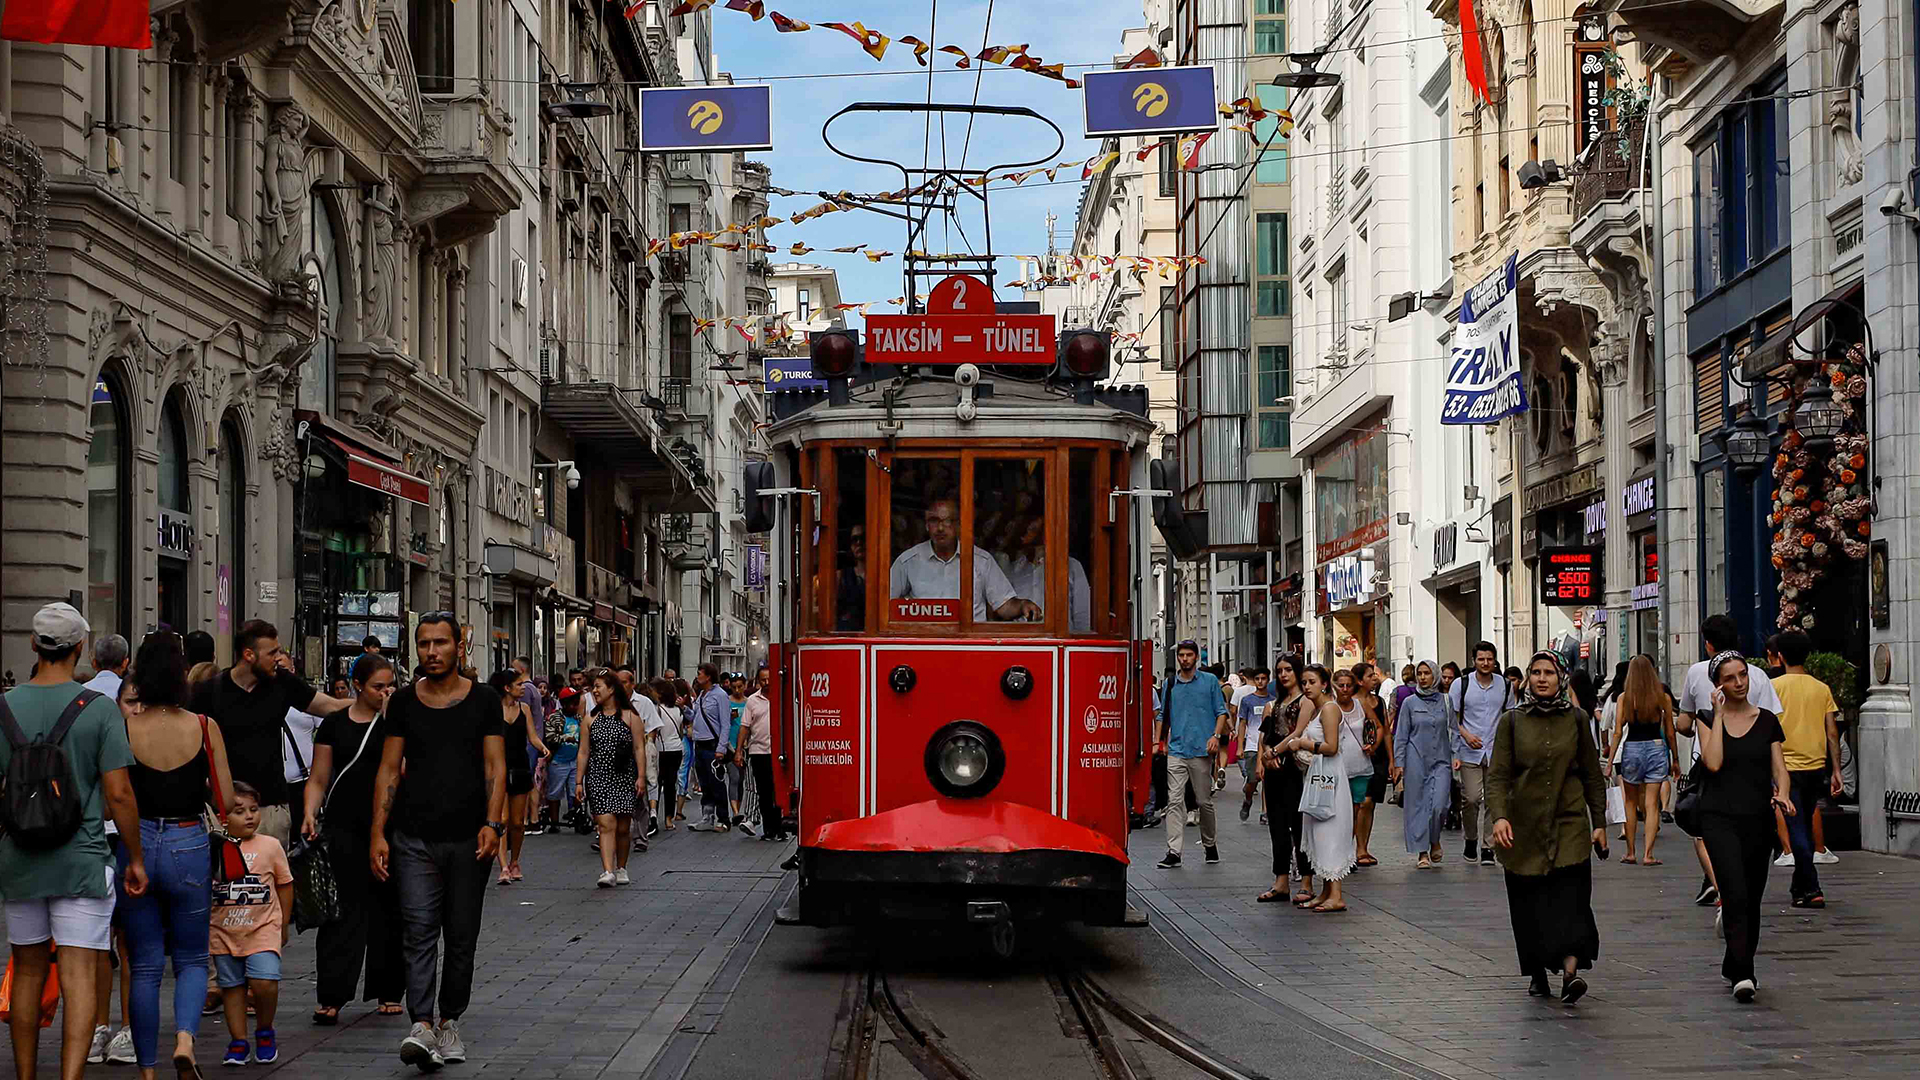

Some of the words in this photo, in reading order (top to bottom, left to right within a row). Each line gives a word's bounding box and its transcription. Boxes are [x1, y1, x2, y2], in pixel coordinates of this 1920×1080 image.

[953, 280, 967, 310] 2
[872, 321, 942, 352] TAKSİM
[983, 321, 1044, 352] TÜNEL
[1622, 477, 1654, 517] CHANGE
[1550, 554, 1591, 563] CHANGE
[898, 602, 952, 616] TÜNEL
[811, 673, 829, 697] 223
[1098, 675, 1117, 699] 223
[827, 718, 841, 727] 153
[1100, 720, 1113, 728] ALO
[827, 740, 851, 750] YASAK
[1082, 743, 1111, 754] ASILMAK
[1081, 758, 1090, 767] VE
[228, 908, 252, 917] SURF
